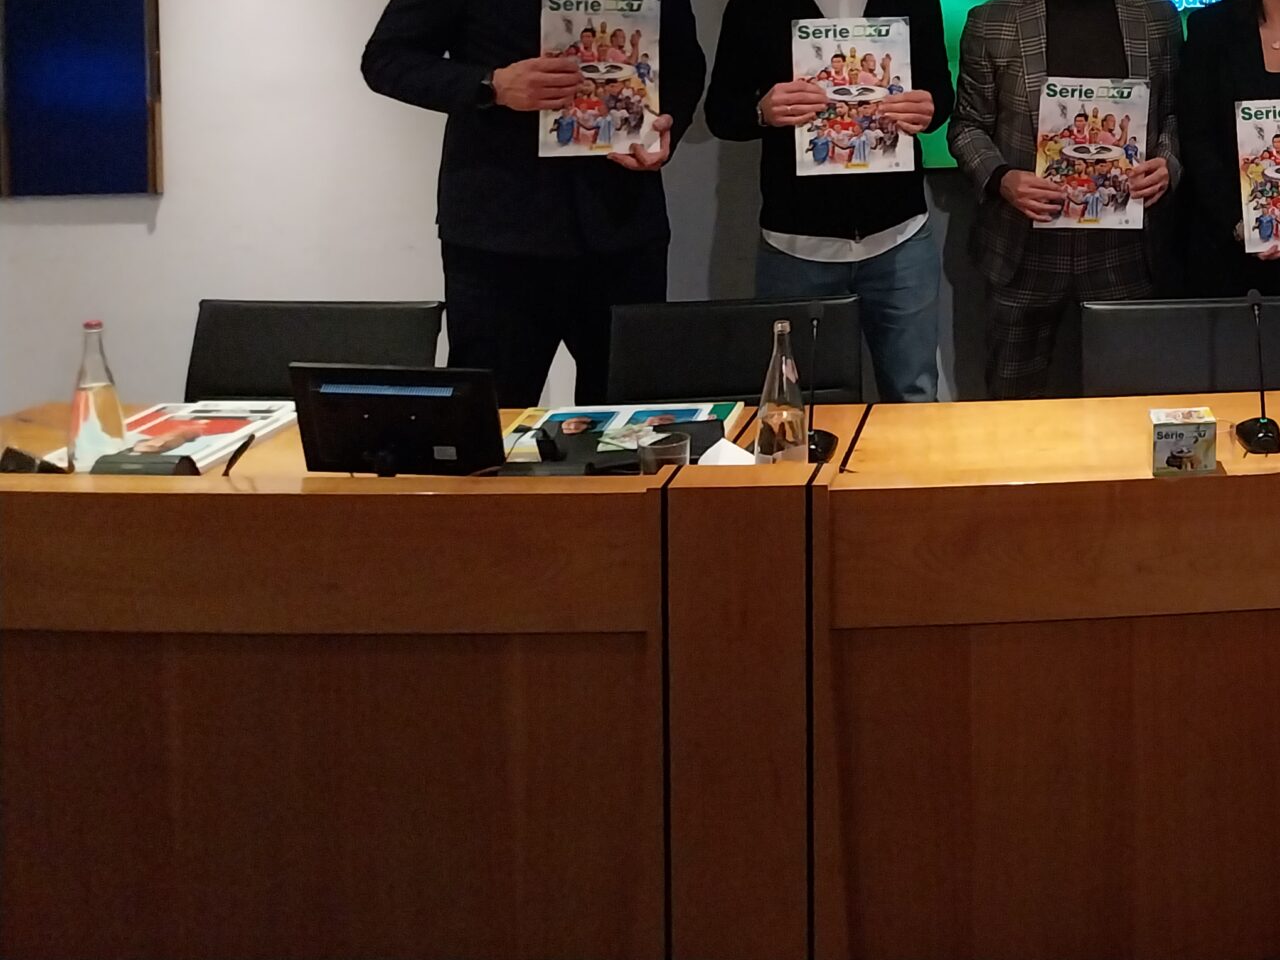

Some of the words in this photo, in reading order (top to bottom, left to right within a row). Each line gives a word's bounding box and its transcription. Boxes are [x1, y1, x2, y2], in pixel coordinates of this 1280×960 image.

[797, 24, 850, 40] Serie
[852, 24, 891, 38] KT
[1046, 83, 1095, 99] Serie
[1156, 430, 1185, 441] Serie
